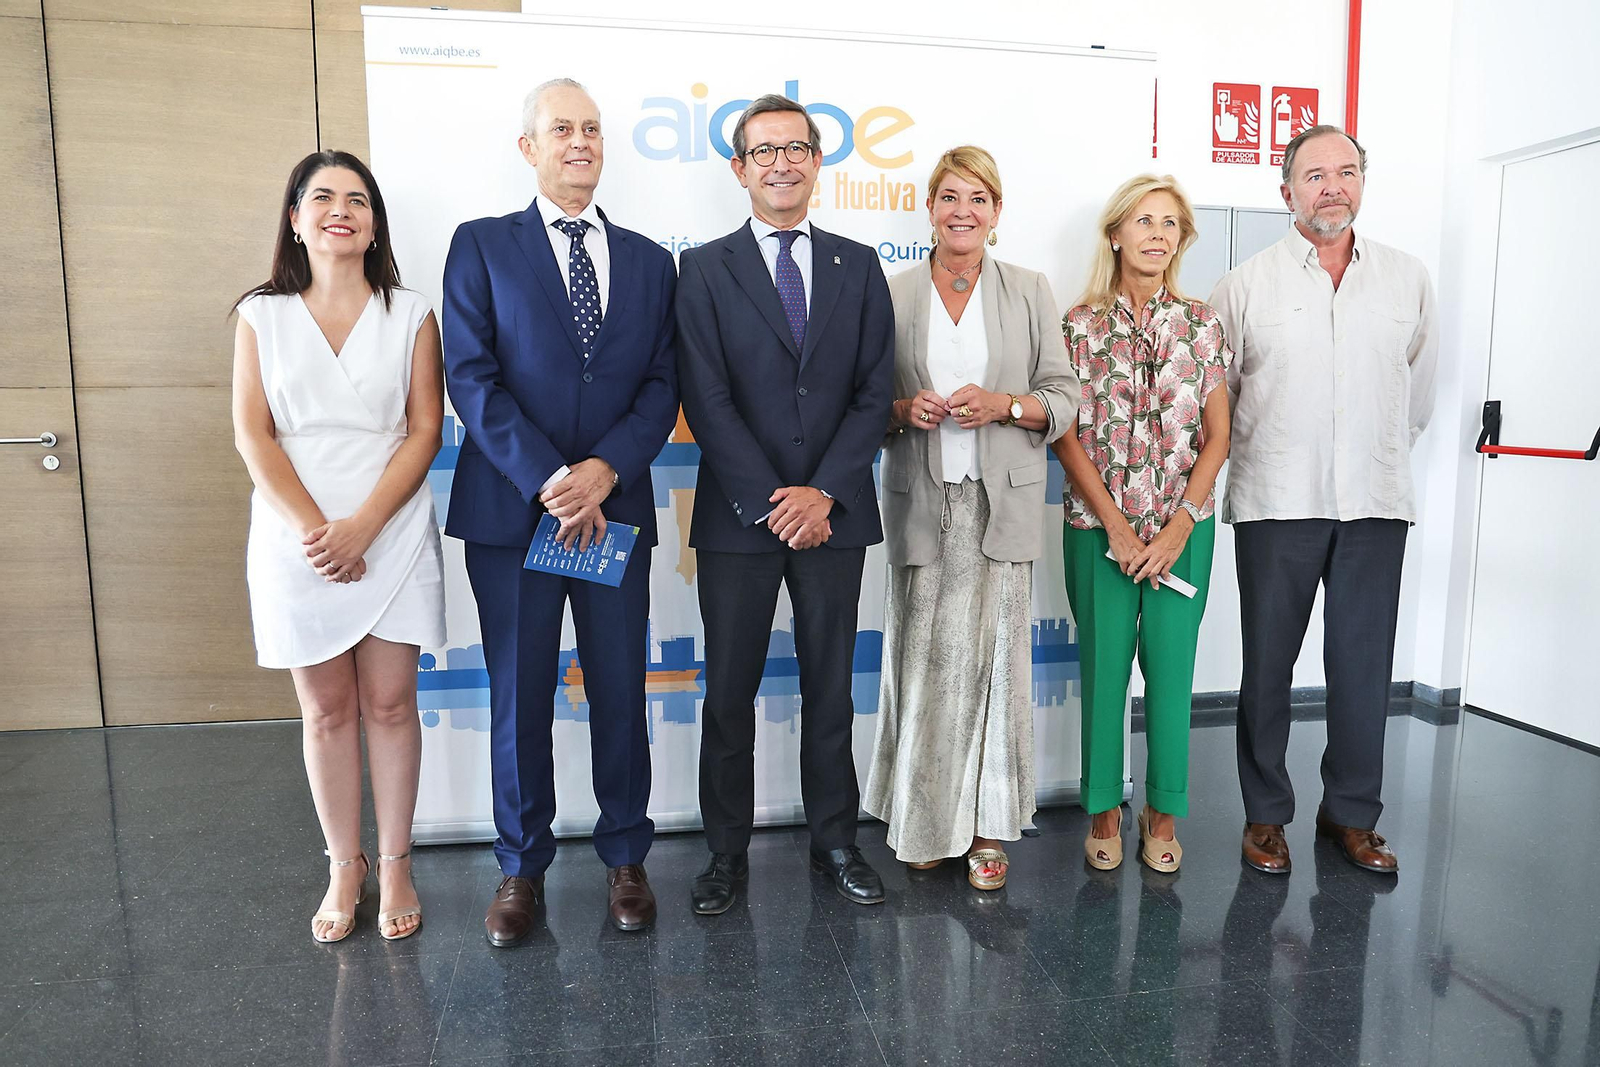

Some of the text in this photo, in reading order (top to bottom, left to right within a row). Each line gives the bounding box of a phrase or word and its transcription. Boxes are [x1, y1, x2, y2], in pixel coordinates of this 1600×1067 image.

[399, 45, 481, 58] www.aiqbe.es
[1217, 151, 1255, 159] PULSADOR
[835, 171, 916, 212] Huelva
